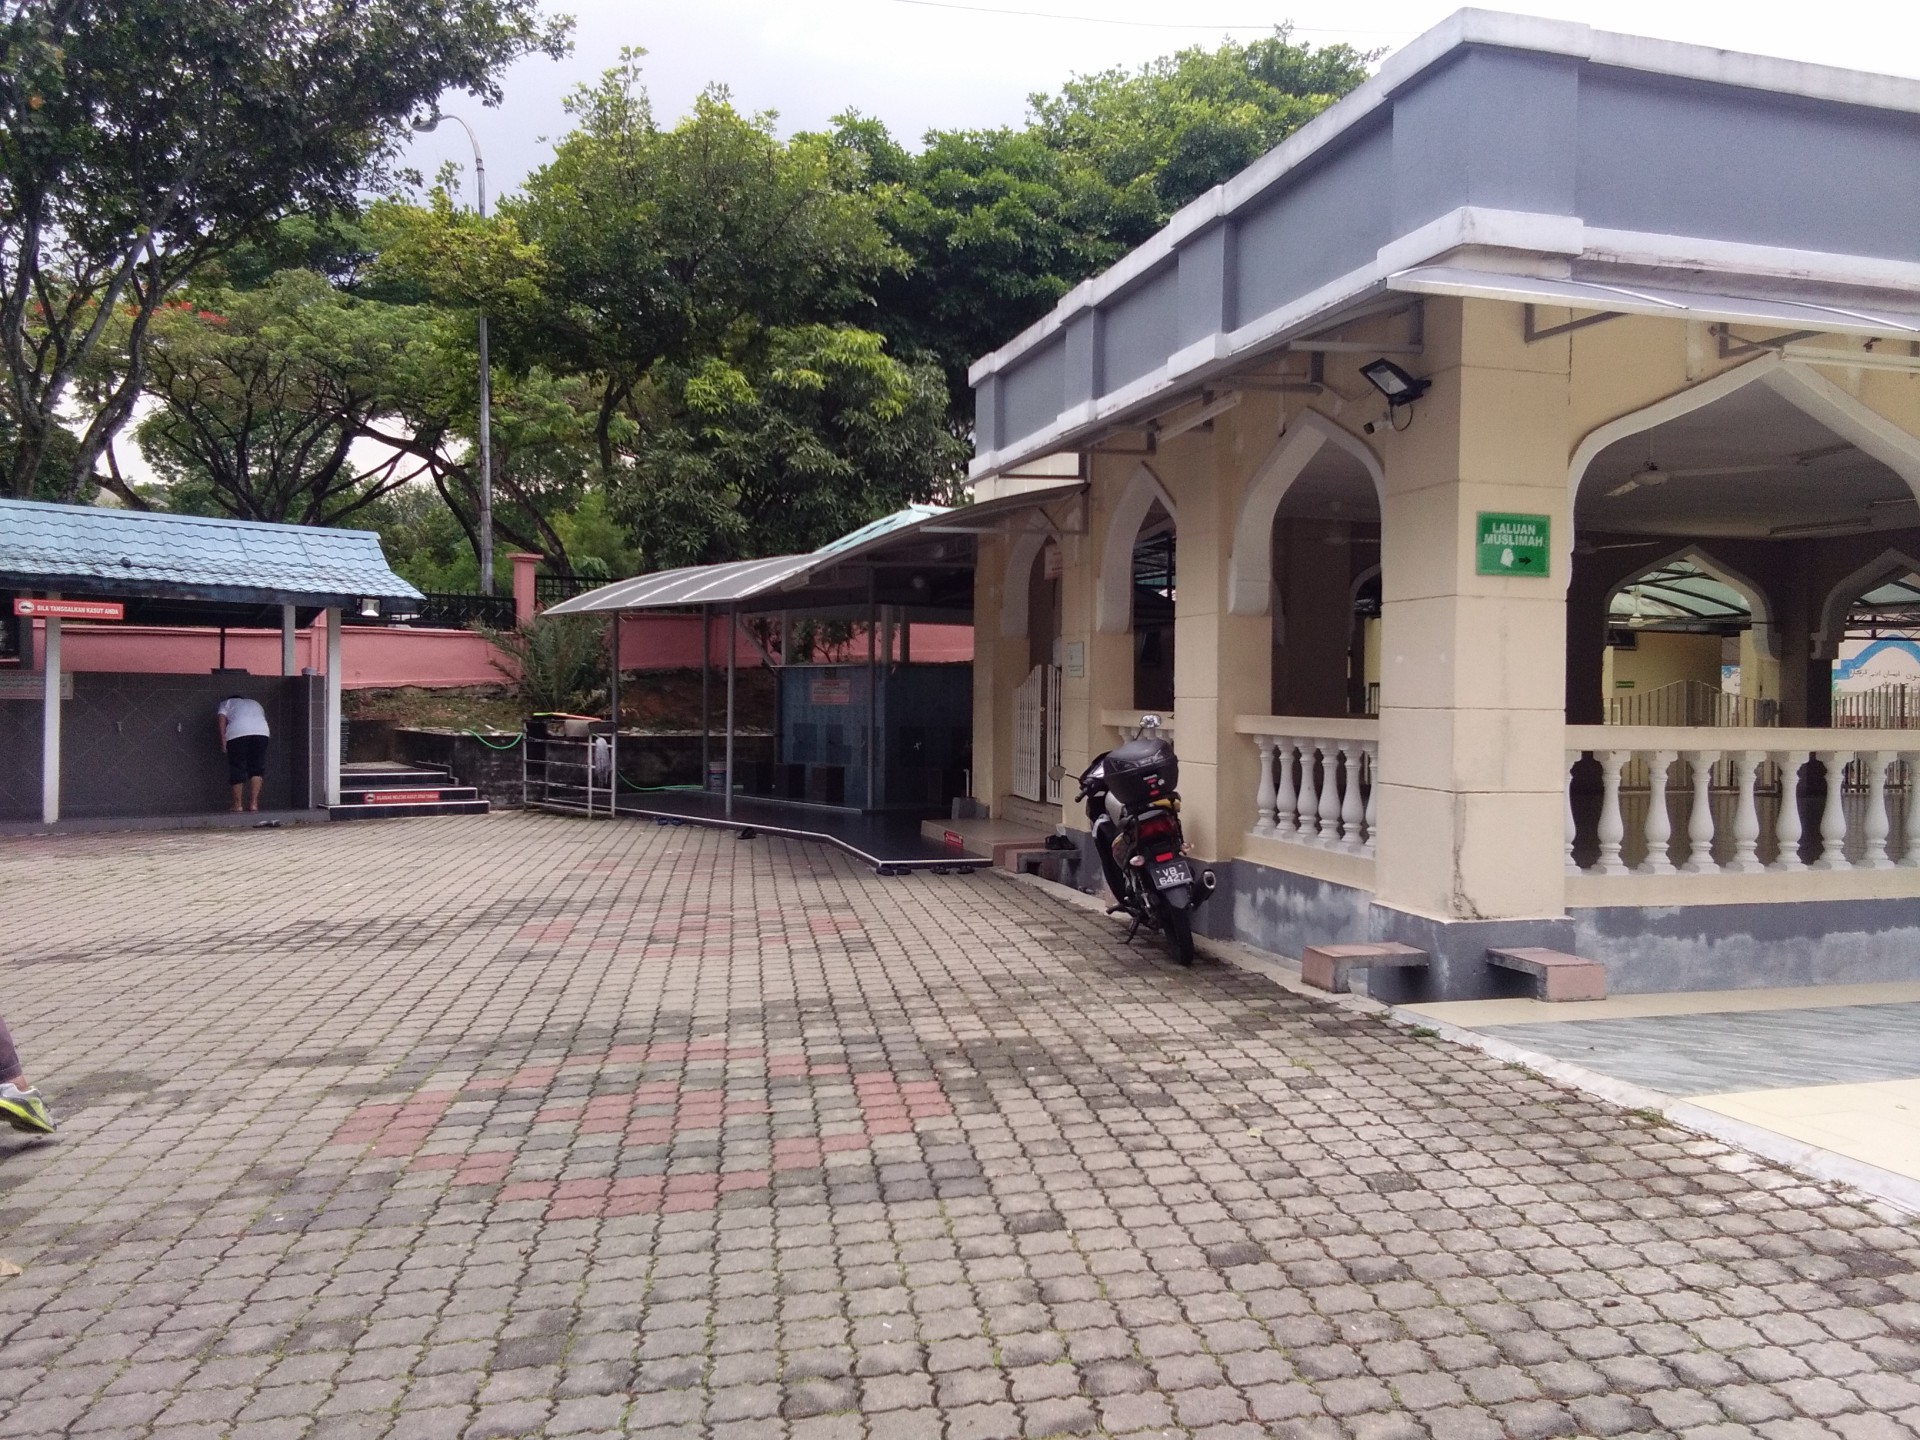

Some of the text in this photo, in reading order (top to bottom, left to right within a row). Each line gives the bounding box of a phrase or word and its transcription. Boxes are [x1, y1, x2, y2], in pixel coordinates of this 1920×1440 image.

[1492, 522, 1536, 535] LALUAN
[1483, 533, 1543, 547] MUSLIMAH
[1159, 872, 1185, 885] 6427
[1162, 867, 1177, 877] VB
